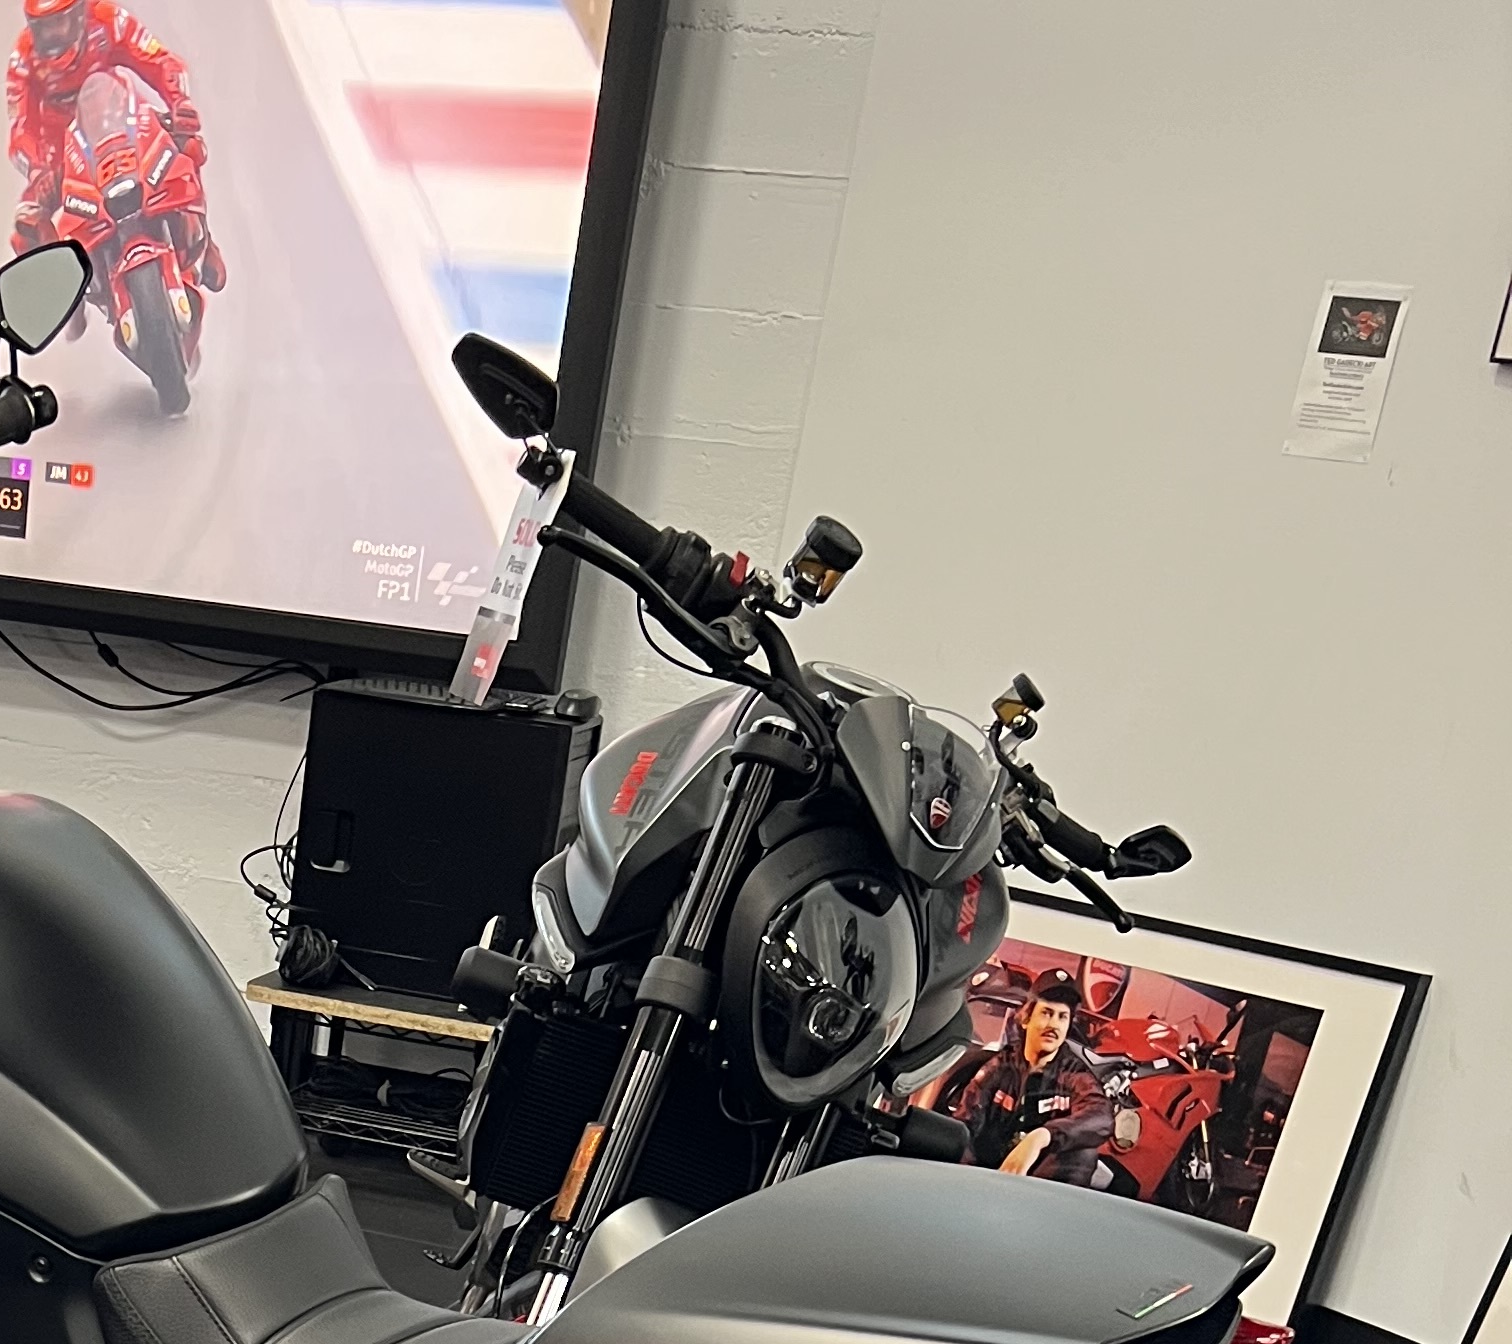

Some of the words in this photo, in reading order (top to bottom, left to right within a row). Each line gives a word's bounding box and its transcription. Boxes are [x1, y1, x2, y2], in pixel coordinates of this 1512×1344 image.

[66, 195, 97, 215] Lenovo
[352, 540, 417, 559] #DutchGP
[365, 560, 414, 577] MotoGP
[377, 579, 411, 601] FP1
[609, 751, 659, 816] DUCATI
